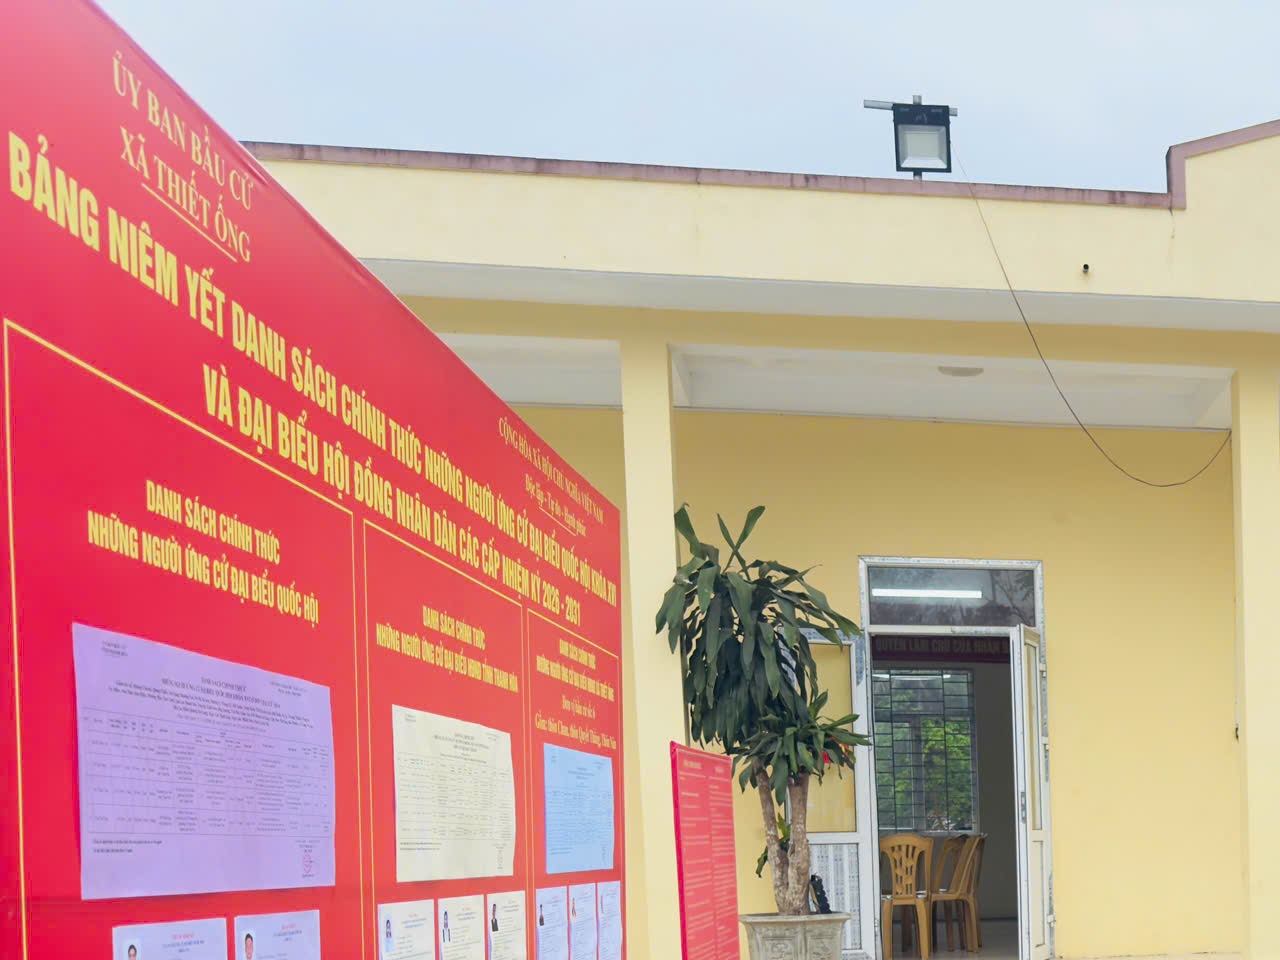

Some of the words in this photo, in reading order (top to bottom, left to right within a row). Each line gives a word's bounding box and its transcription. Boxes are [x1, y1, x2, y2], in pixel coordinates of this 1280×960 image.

[112, 50, 142, 111] ỦY
[147, 88, 185, 153] BAN
[191, 125, 225, 187] BẦU
[229, 169, 254, 211] CỬ
[120, 125, 150, 180] XÃ
[153, 156, 211, 230] THIẾT
[215, 194, 251, 263] ỐNG
[9, 131, 100, 252] BẢNG
[108, 206, 178, 307] NIÊM
[184, 264, 225, 339] YẾT
[232, 300, 287, 382] DANH
[291, 347, 337, 417] SÁCH
[341, 384, 386, 451] CHÍNH
[389, 417, 422, 475] THỨC
[425, 445, 463, 503] NHỮNG
[465, 475, 495, 525] NGƯỜI
[497, 493, 515, 539] ỨNG
[517, 509, 528, 548] CỬ
[529, 522, 543, 562] ĐẠI
[544, 529, 561, 569] BIỂU
[561, 545, 579, 582] QUỐC
[146, 479, 182, 524] DANH
[185, 496, 216, 538] SÁCH
[219, 514, 252, 554] CHÍNH
[255, 529, 280, 565] THỨC
[202, 363, 233, 427] VÀ
[238, 386, 272, 455] ĐẠI
[278, 409, 319, 476] BIỂU
[323, 441, 351, 501] HỘI
[354, 456, 392, 520] ĐỒNG
[396, 488, 431, 542] NHÂN
[434, 509, 457, 557] DÂN
[460, 525, 480, 569] CÁC
[482, 537, 501, 580] CẤP
[502, 553, 530, 600] NHIỆM
[543, 580, 560, 616] 2026
[566, 594, 580, 627] 2031
[88, 510, 139, 560] NHỮNG
[141, 531, 182, 576] NGƯỜI
[185, 543, 210, 585] ỨNG
[213, 553, 229, 592] CỬ
[231, 566, 249, 604] ĐẠI
[251, 568, 274, 609] BIỂU
[276, 580, 302, 618] QUỐC
[303, 592, 319, 628] HỘI
[376, 622, 400, 652] NHỮNG
